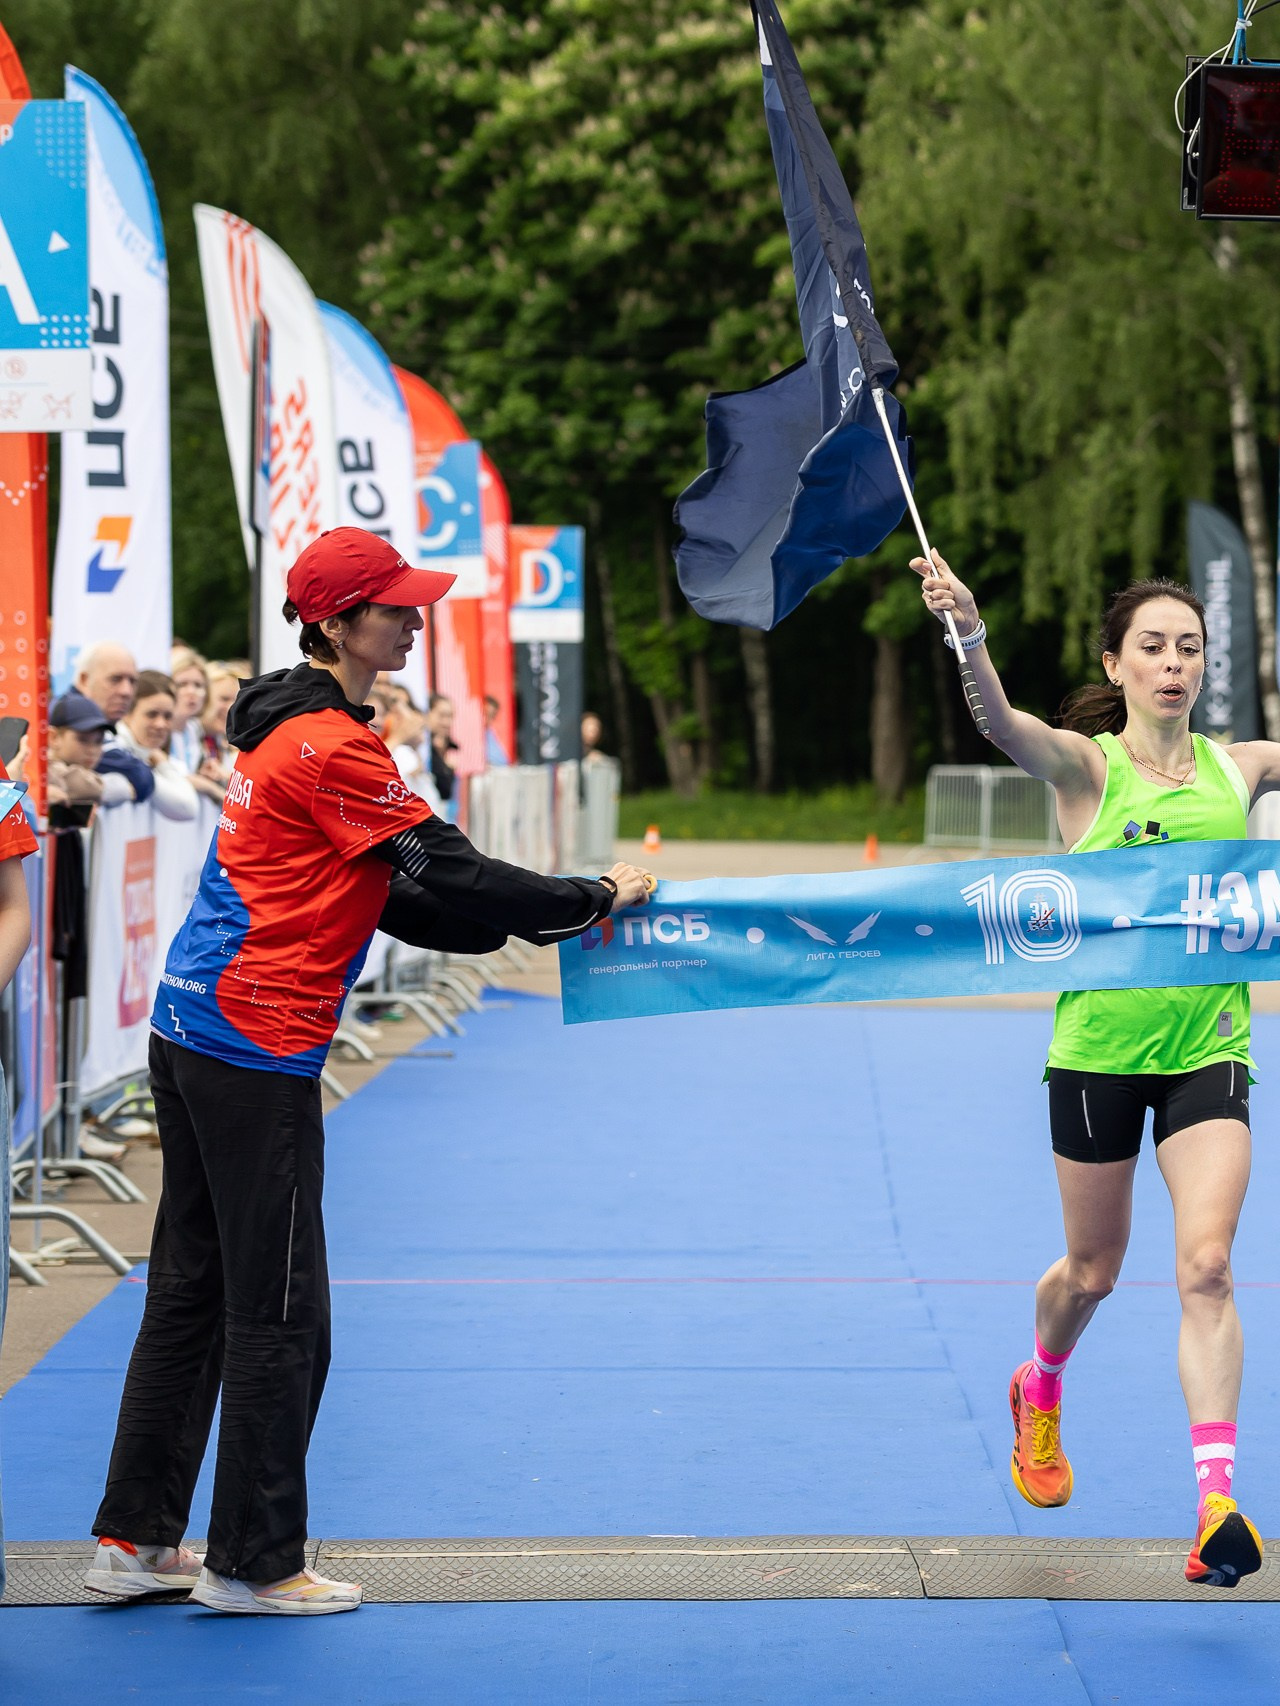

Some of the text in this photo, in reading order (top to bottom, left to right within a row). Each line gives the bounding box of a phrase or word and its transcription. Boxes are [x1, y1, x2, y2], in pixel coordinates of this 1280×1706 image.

[520, 549, 564, 606] D
[622, 912, 711, 947] ПСБ
[959, 868, 1082, 965] 10
[588, 957, 708, 976] генеральный партнер
[805, 949, 882, 962] ЛИГА ГЕРОЕВ
